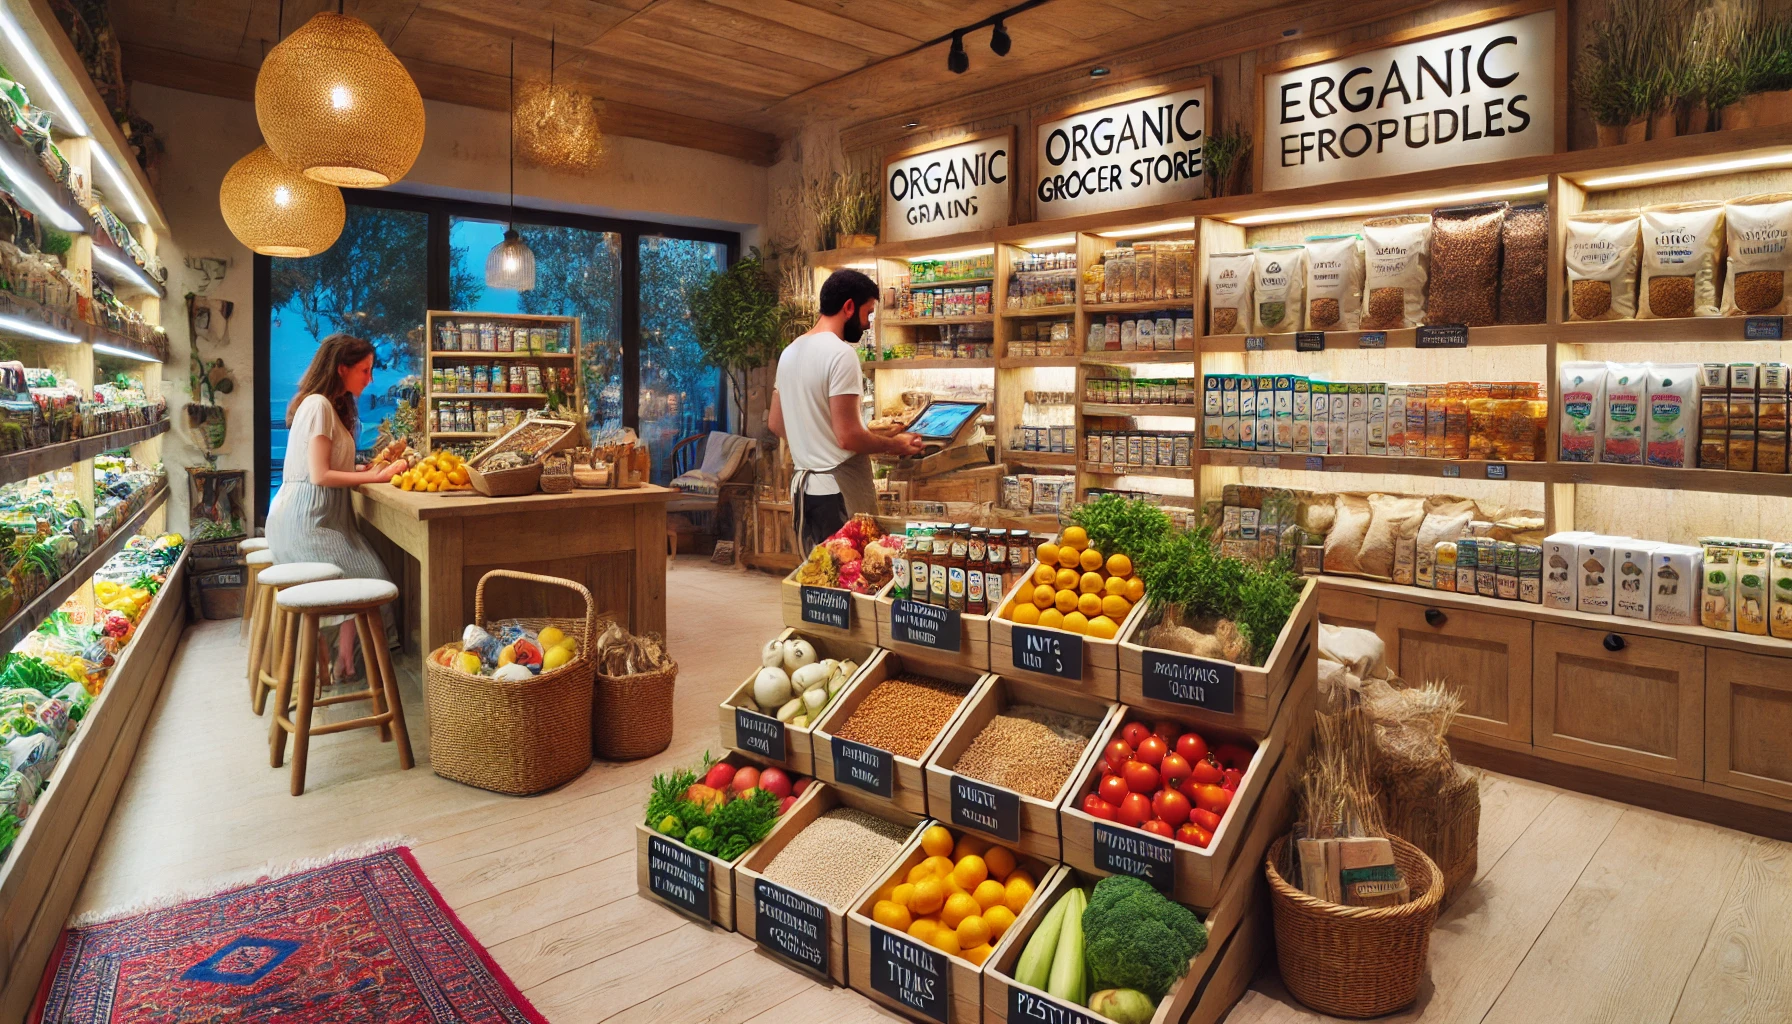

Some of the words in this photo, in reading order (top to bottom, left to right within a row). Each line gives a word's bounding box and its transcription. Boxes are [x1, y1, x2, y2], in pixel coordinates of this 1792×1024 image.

[1045, 99, 1202, 166] ORGANIC
[889, 149, 1007, 202] ORGANIC
[1037, 164, 1122, 202] GROCER
[1129, 147, 1203, 188] STORE
[906, 195, 978, 225] GRAINS
